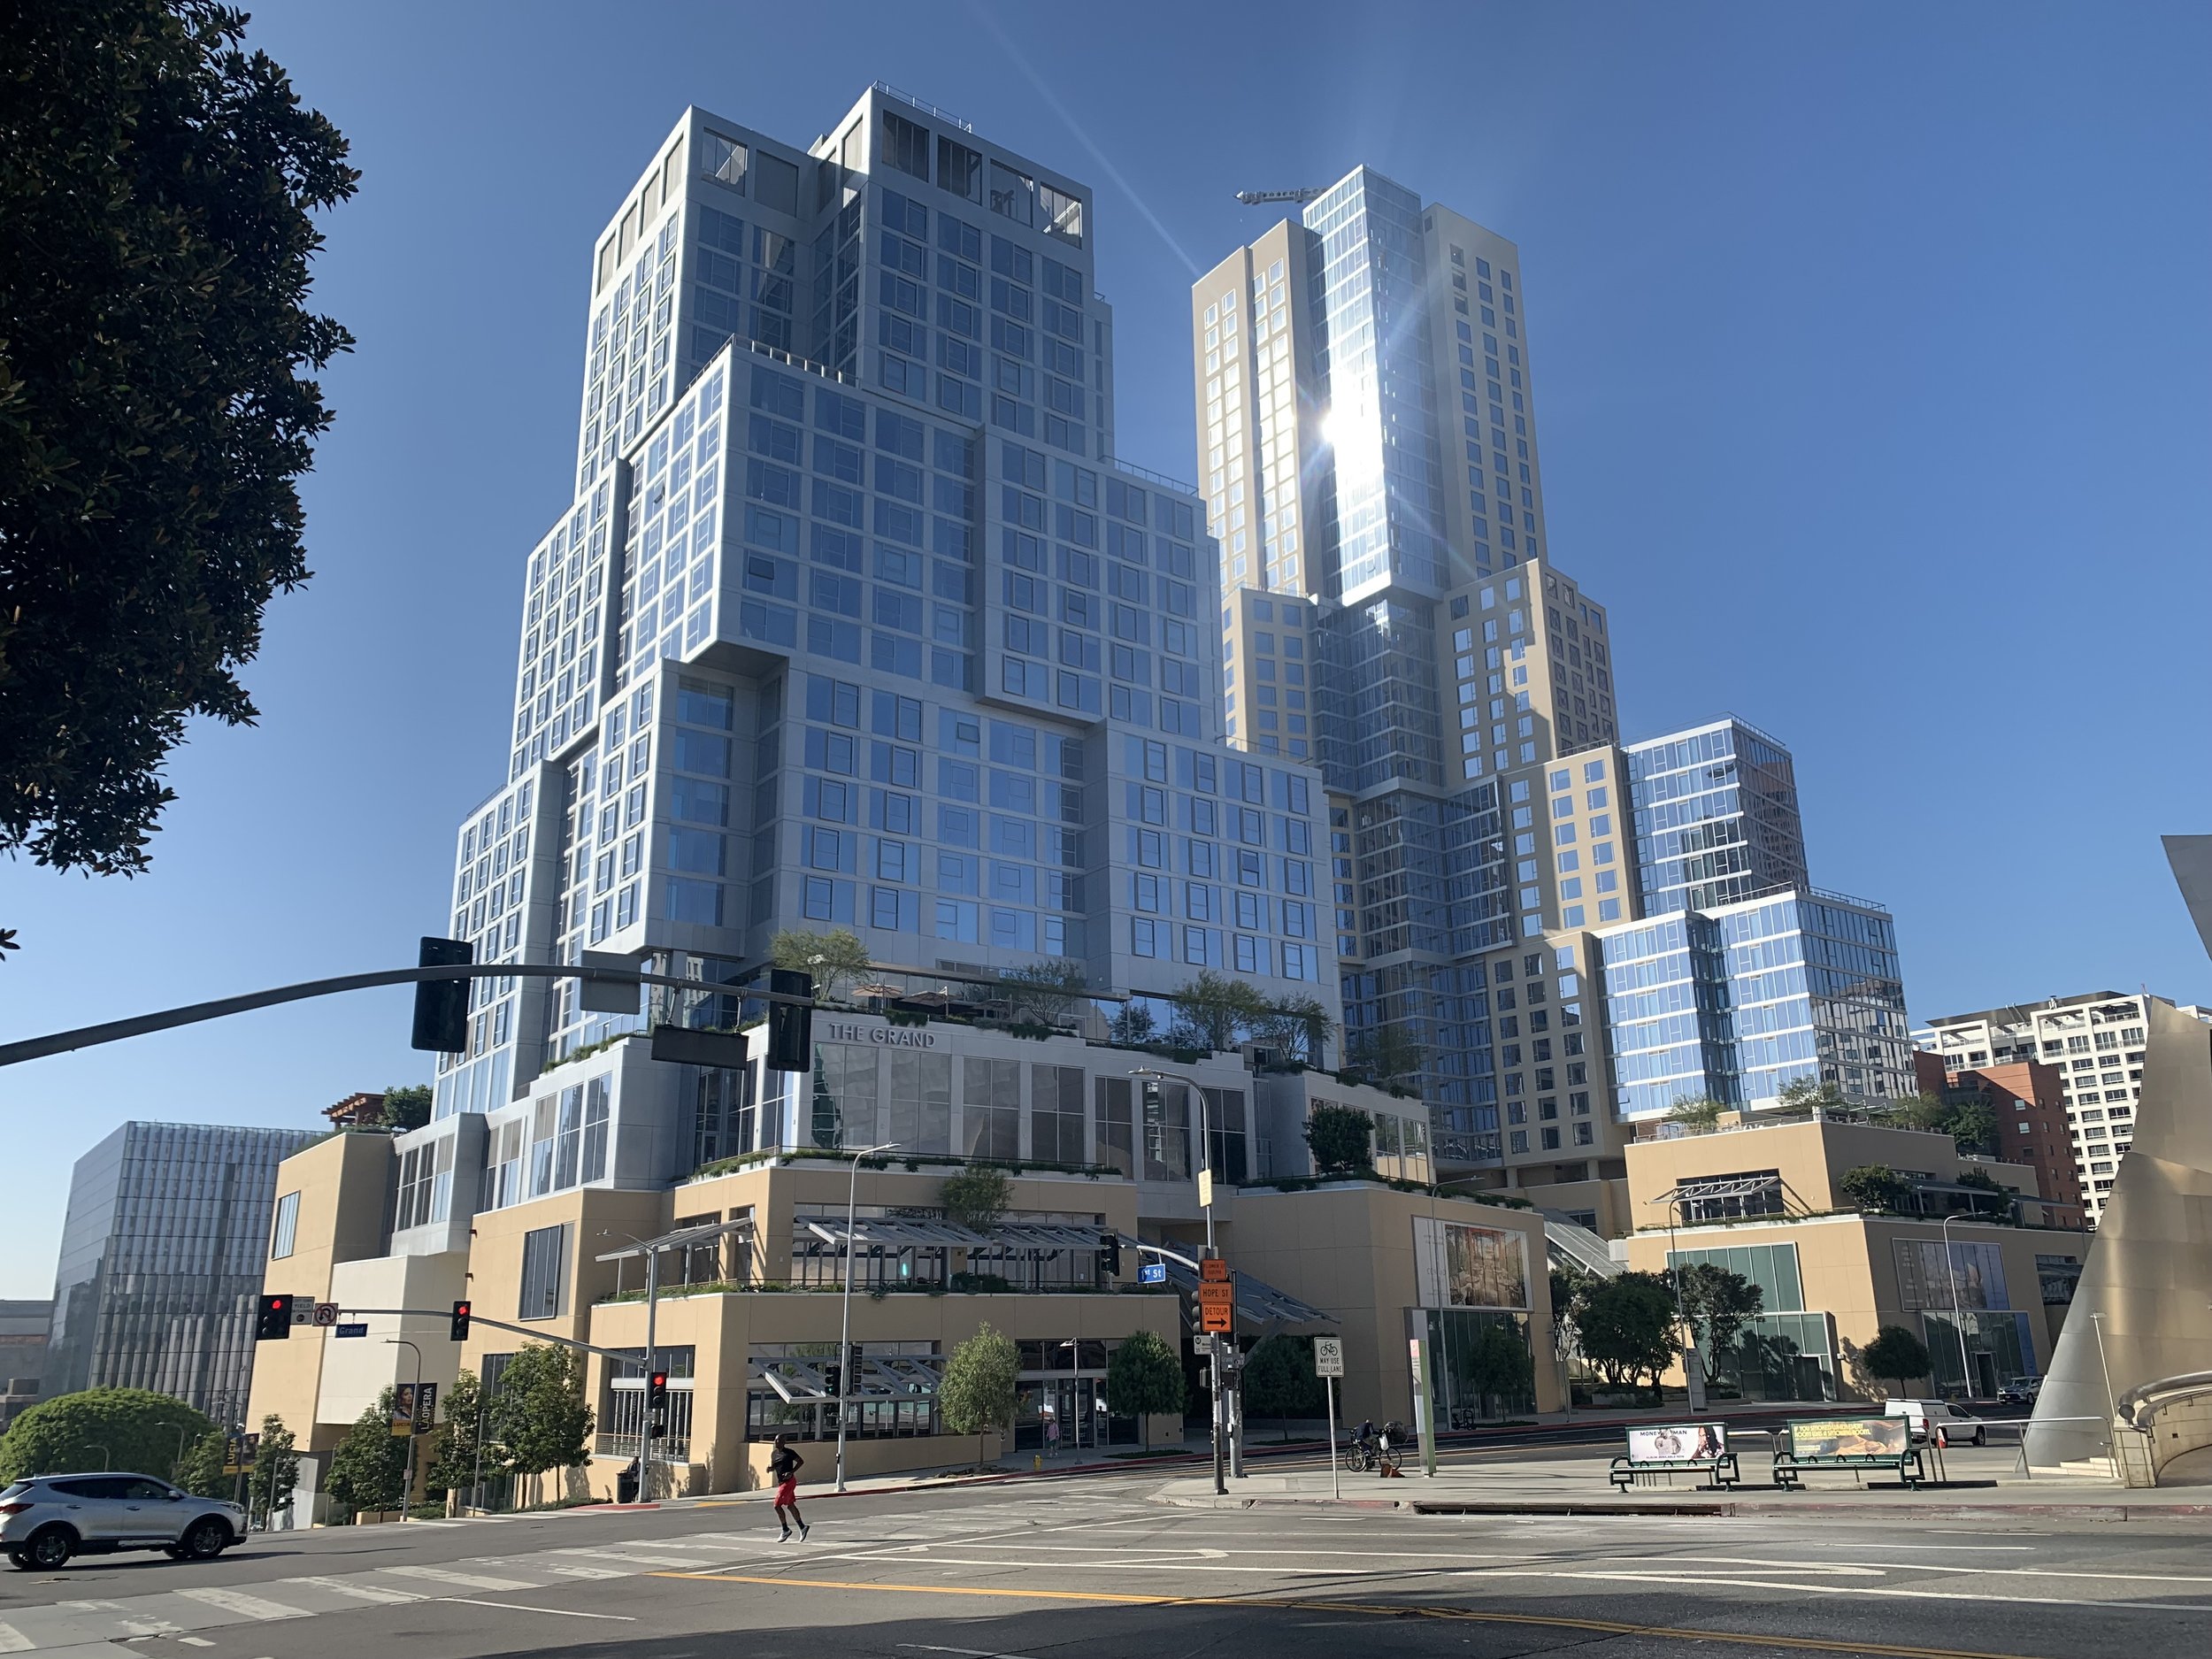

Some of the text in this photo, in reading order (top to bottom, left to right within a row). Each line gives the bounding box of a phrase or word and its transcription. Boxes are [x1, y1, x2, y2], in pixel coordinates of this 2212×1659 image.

[830, 1024, 936, 1048] THE GRAND
[1153, 1269, 1161, 1278] St
[1203, 1288, 1219, 1297] HOPE
[1205, 1307, 1228, 1316] DETOUR
[227, 1437, 237, 1464] LUCIA
